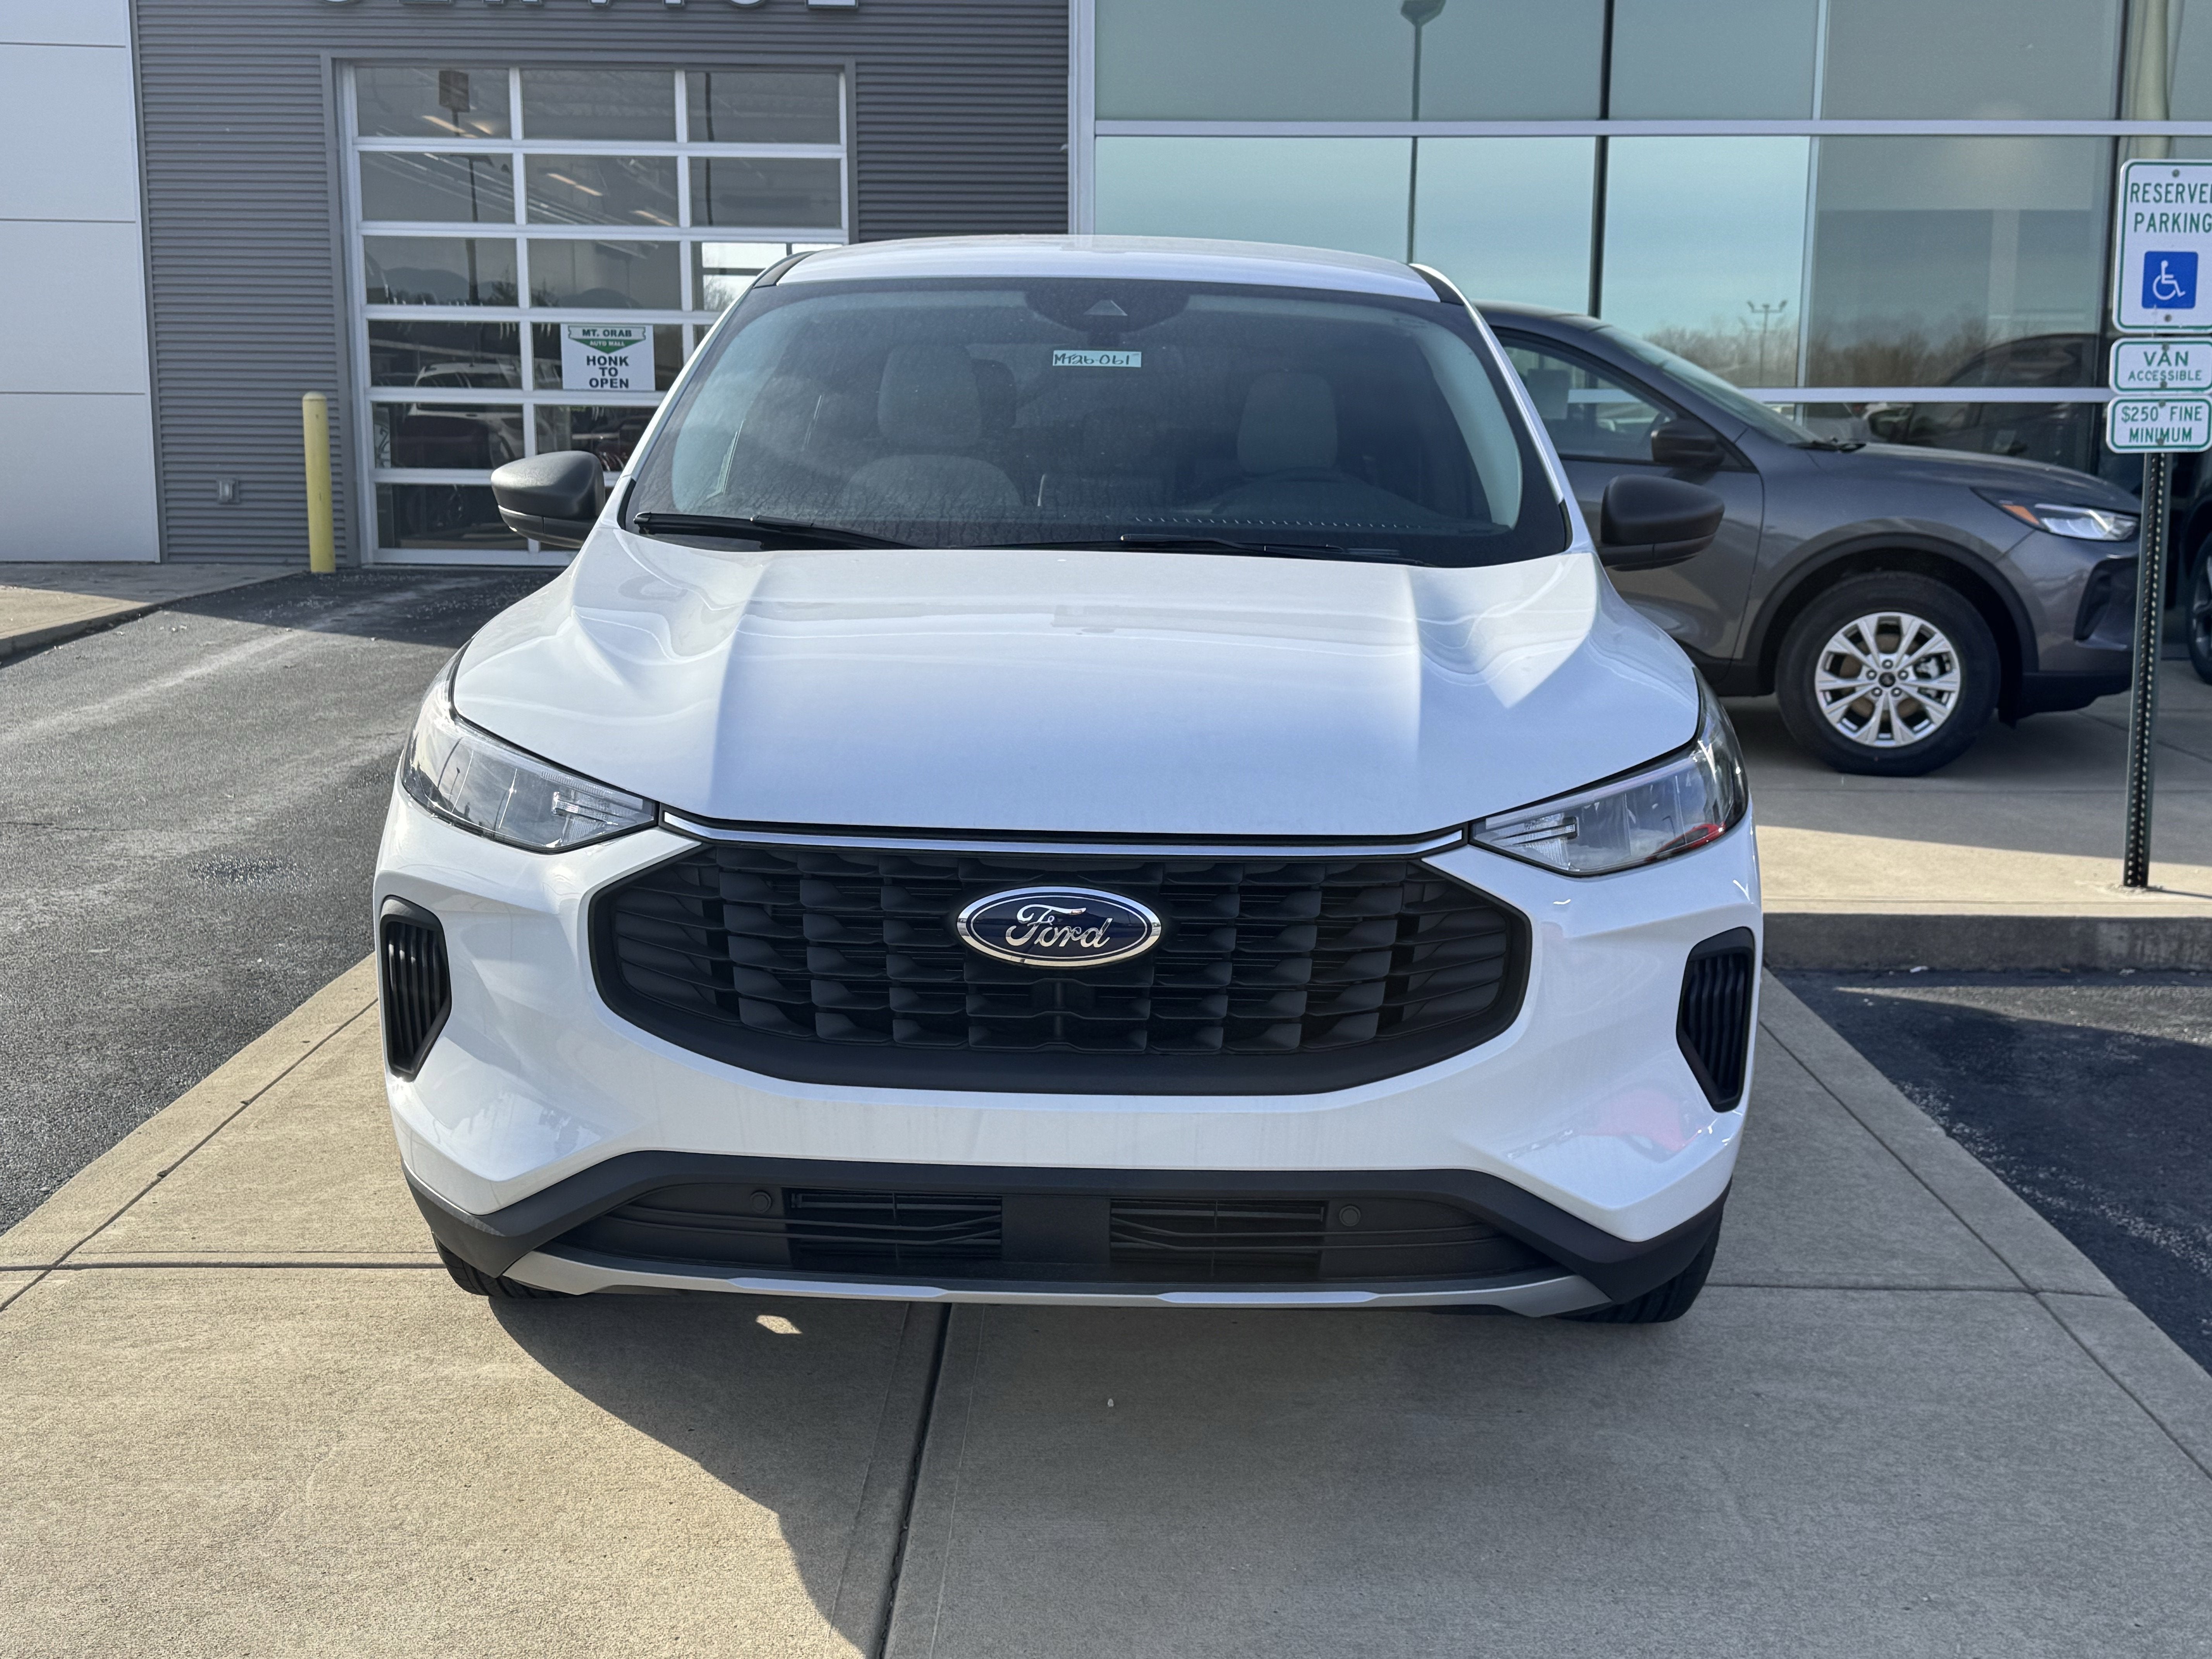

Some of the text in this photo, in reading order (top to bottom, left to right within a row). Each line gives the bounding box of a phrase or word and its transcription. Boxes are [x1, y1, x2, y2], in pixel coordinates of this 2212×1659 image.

[2130, 182, 2212, 204] RESERVE
[2133, 212, 2212, 233] PARKING
[582, 329, 632, 337] MT. ORAB
[586, 355, 629, 366] HONK
[2143, 350, 2188, 367] VAN
[599, 367, 618, 377] TO
[2128, 370, 2202, 382] ACCESSIBLE
[589, 378, 629, 388] OPEN
[2121, 405, 2203, 423] $250 FINE
[2129, 427, 2192, 443] MINIMUM
[1005, 903, 1113, 948] Ford
